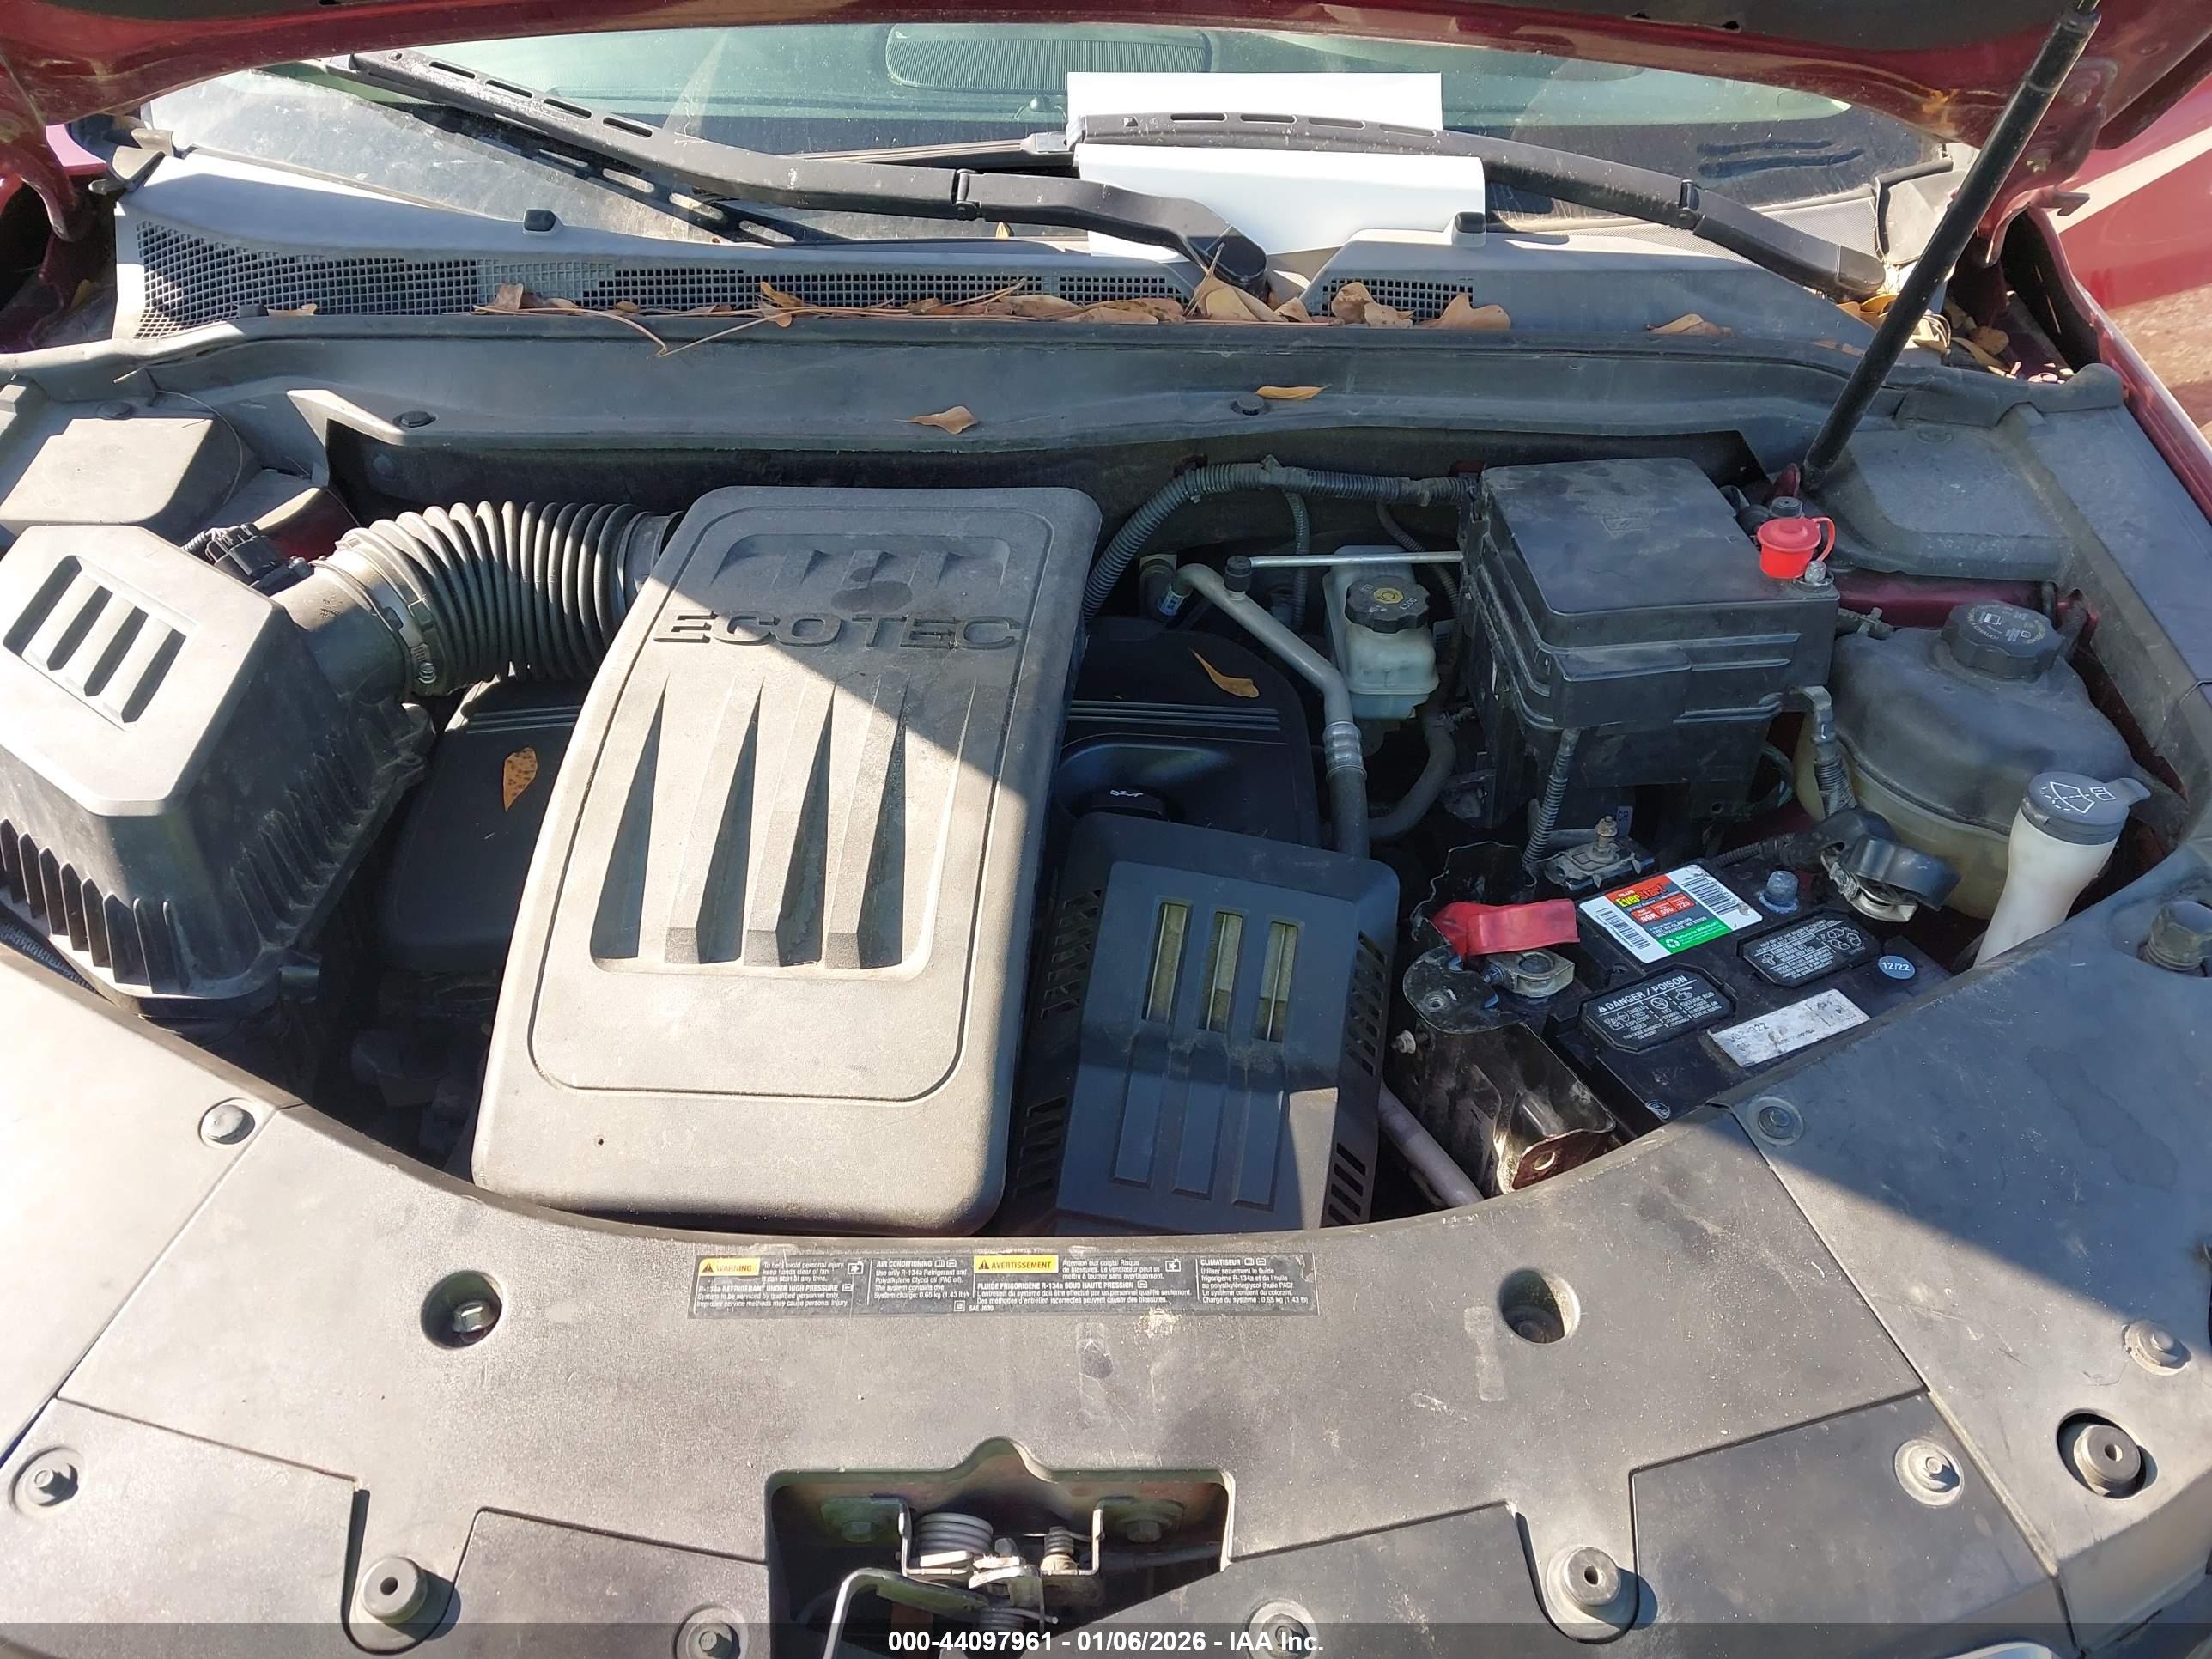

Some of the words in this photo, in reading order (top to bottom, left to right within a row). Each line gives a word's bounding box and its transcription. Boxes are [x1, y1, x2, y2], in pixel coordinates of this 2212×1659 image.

[653, 610, 1021, 649] ECOTEC
[1882, 962, 1910, 971] 12/22
[1606, 991, 1645, 1010] DANGER
[1652, 975, 1688, 992] POISON
